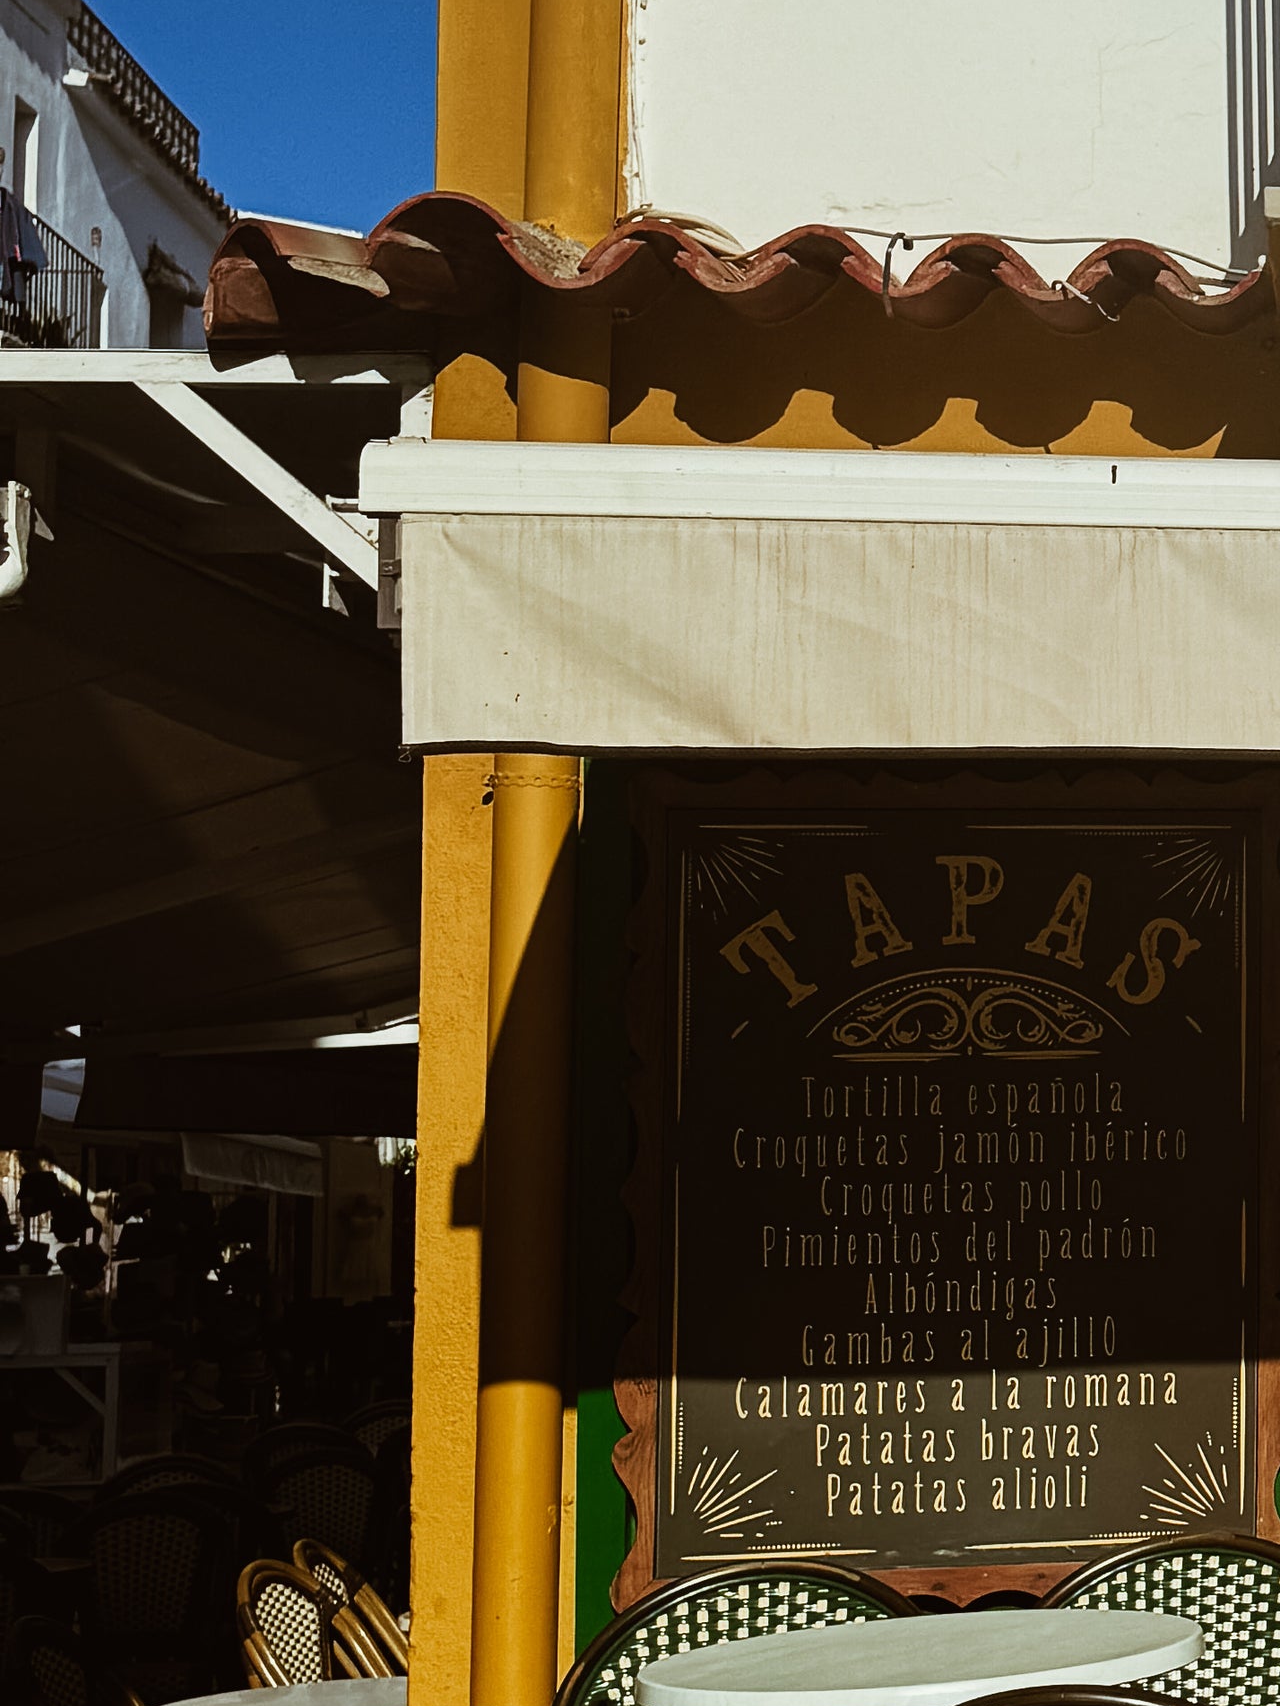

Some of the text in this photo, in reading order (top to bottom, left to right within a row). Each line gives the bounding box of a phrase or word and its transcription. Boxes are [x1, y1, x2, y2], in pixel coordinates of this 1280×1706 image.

[719, 854, 1202, 1009] TAPAS
[800, 1072, 1123, 1126] Tortilla española
[733, 1121, 1187, 1177] Croquetas jamón ibérico
[821, 1170, 1103, 1222] Croquetas pollo
[763, 1218, 1157, 1271] Pimientos del padrón
[864, 1270, 1057, 1320] Albóndigas
[802, 1322, 936, 1365] Gambas
[960, 1320, 989, 1361] al
[735, 1368, 1177, 1419] Calamares a la romana
[816, 1419, 1100, 1466] Patatas bravas
[828, 1466, 1088, 1517] Patatas alioli
